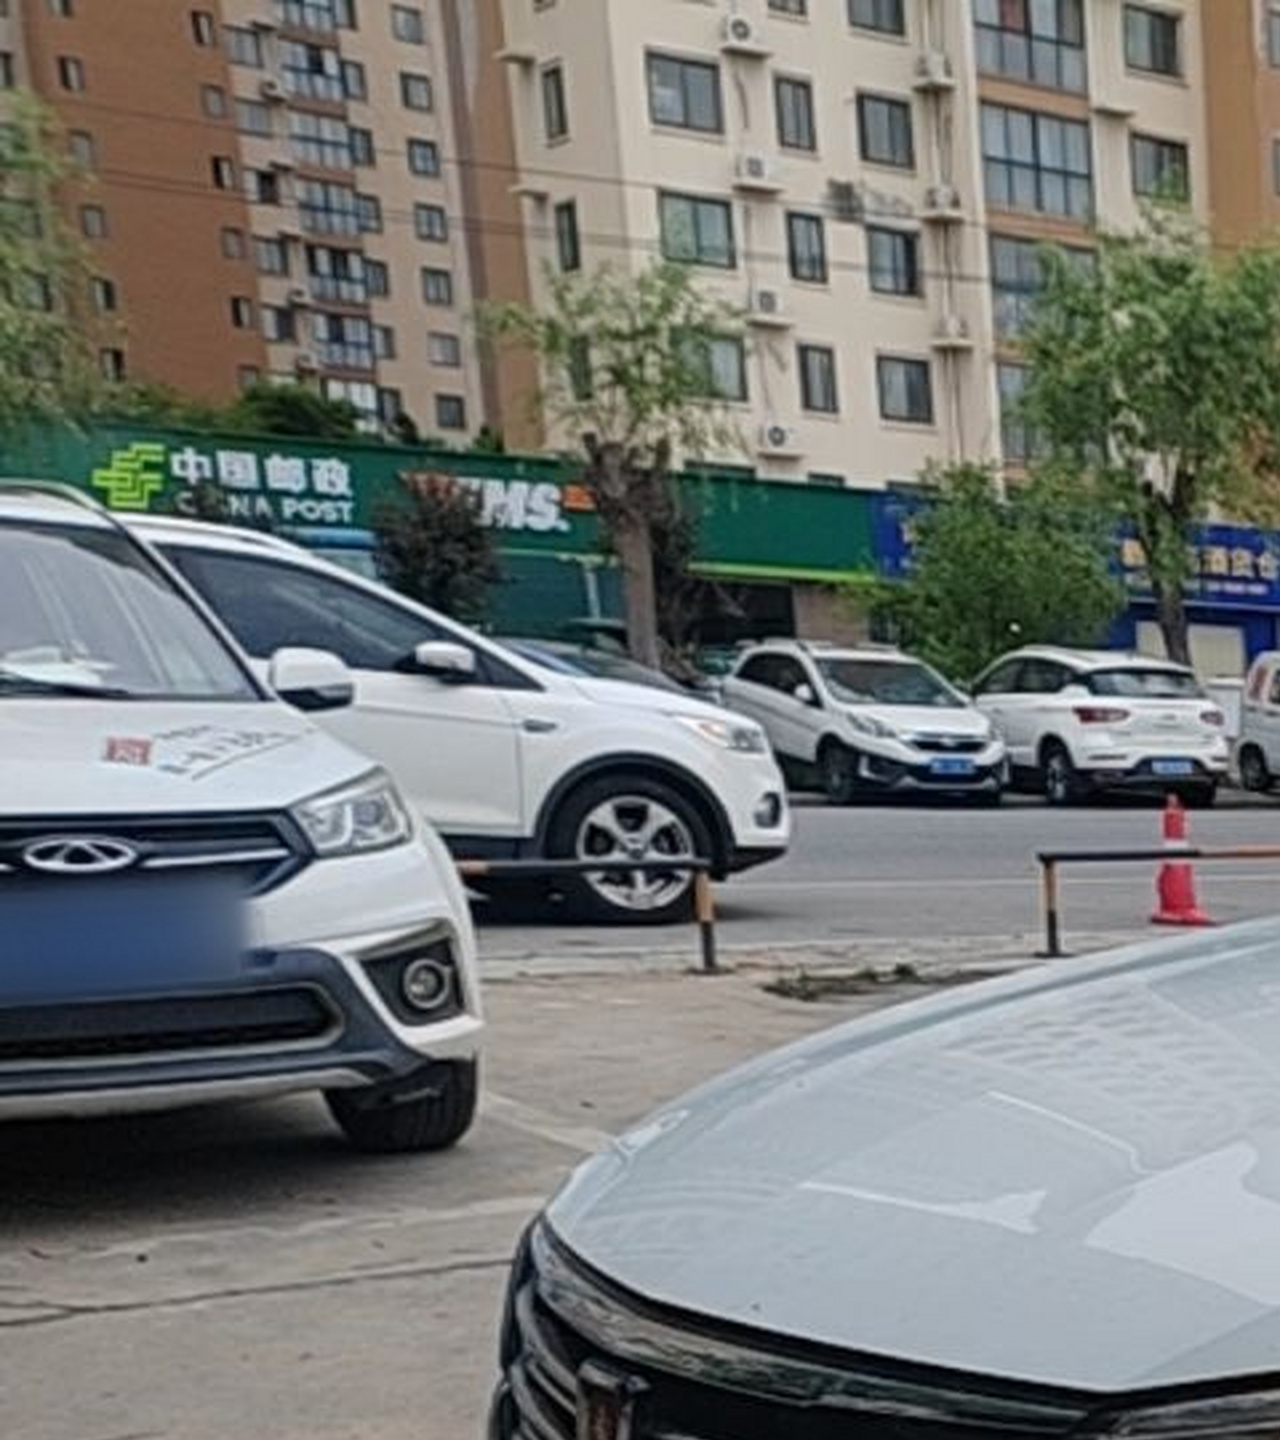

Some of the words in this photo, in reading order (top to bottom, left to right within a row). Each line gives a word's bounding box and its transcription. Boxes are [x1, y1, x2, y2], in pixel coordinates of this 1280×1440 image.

[170, 447, 353, 498] 中国邮政
[281, 499, 354, 523] POST
